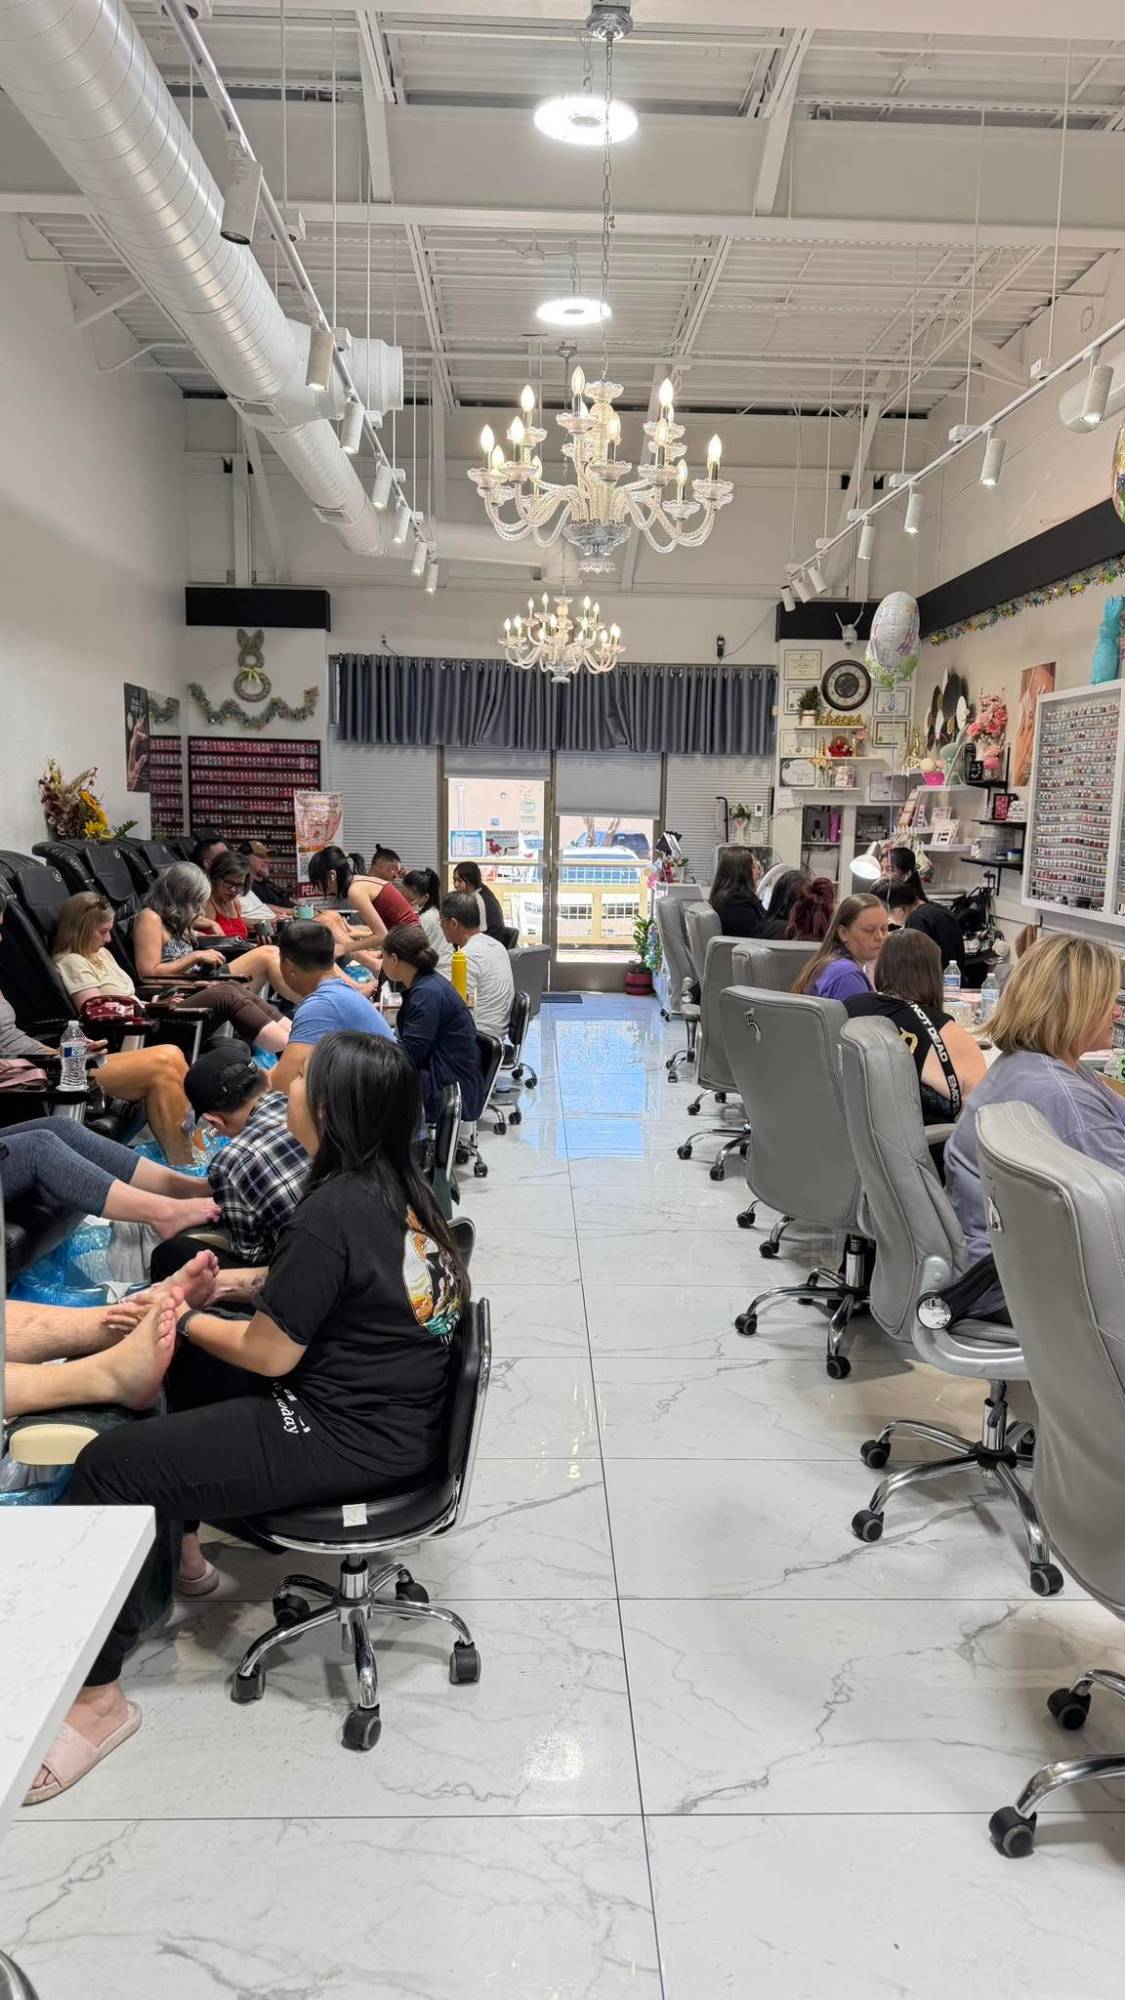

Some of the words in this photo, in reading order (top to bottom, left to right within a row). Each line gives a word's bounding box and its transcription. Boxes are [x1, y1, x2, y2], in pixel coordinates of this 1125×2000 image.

[910, 1003, 932, 1025] NOT
[927, 1027, 948, 1063] DEAD
[276, 1399, 299, 1433] oday
